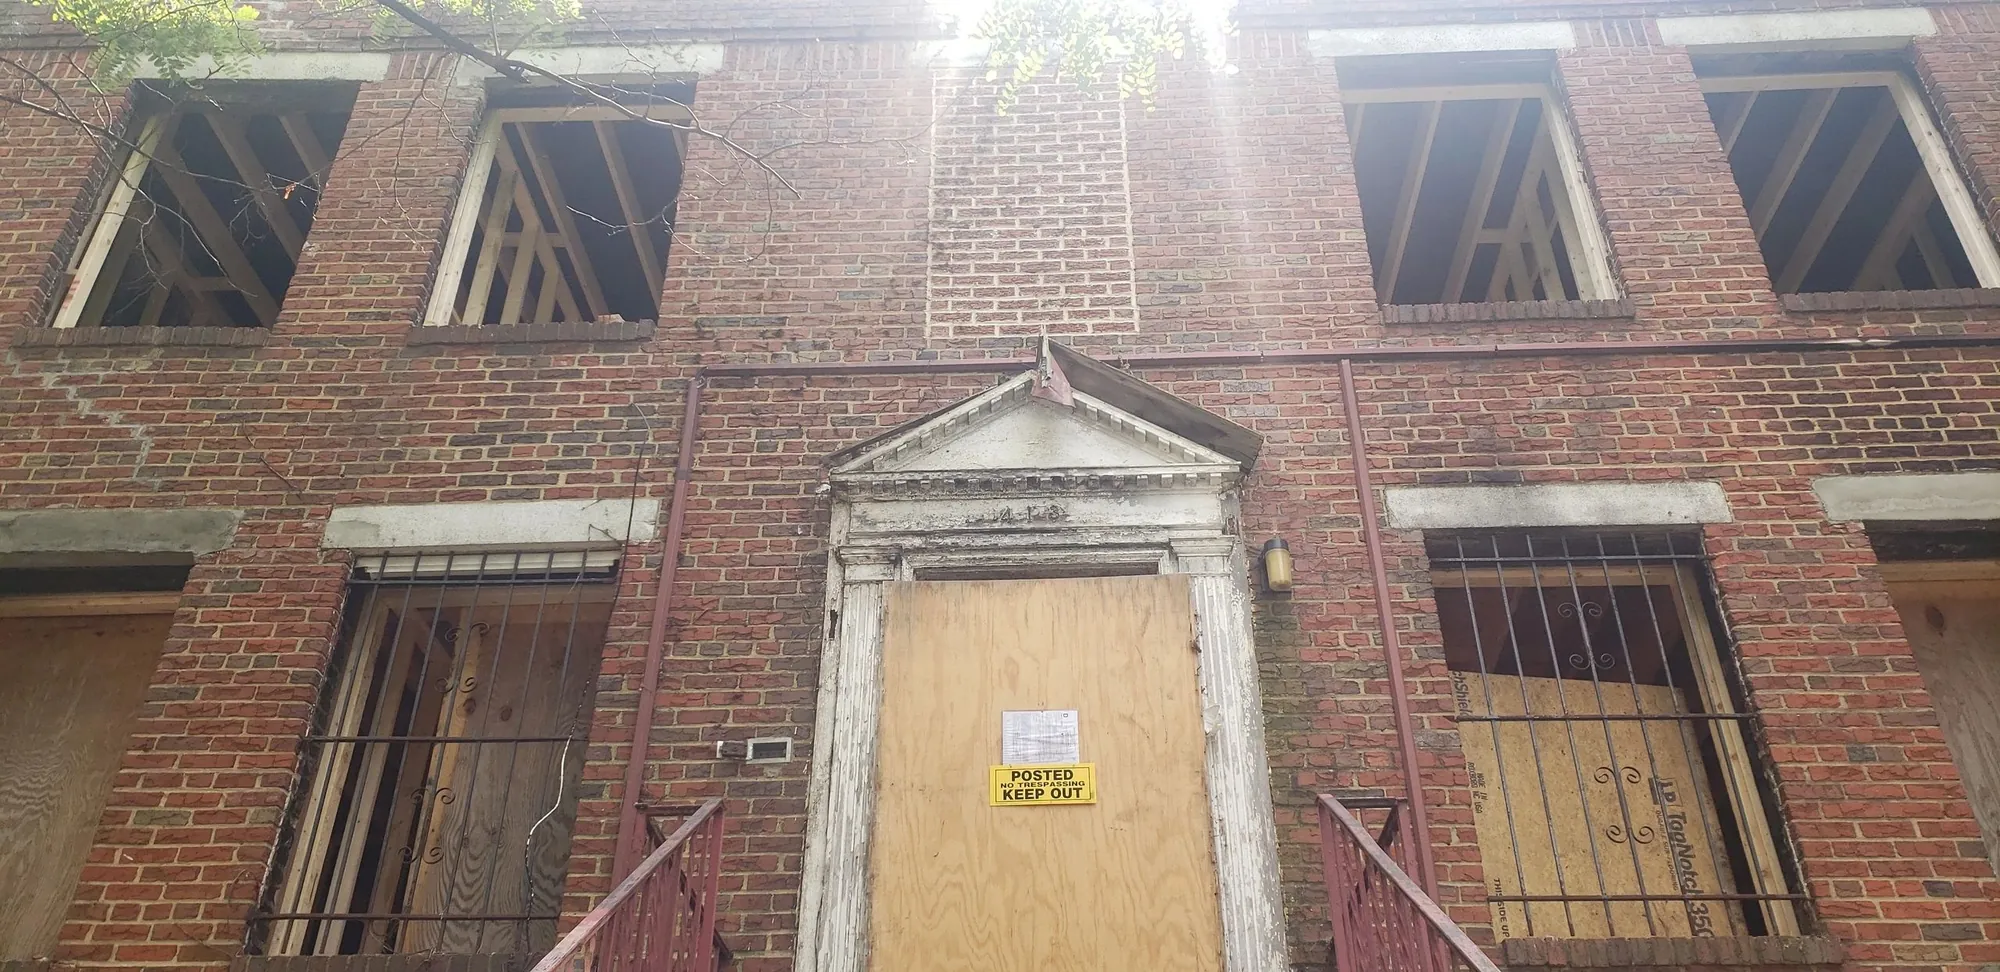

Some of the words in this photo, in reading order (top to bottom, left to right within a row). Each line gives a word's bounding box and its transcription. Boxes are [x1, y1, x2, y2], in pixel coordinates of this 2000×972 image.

[1011, 769, 1074, 782] POSTED
[1476, 773, 1486, 788] MADE
[1017, 780, 1086, 788] TRESPASSING
[1003, 789, 1045, 801] KEEP
[1050, 787, 1083, 799] OUT
[1474, 802, 1483, 814] USA
[1497, 900, 1508, 922] SIDE
[1502, 925, 1510, 938] UP
